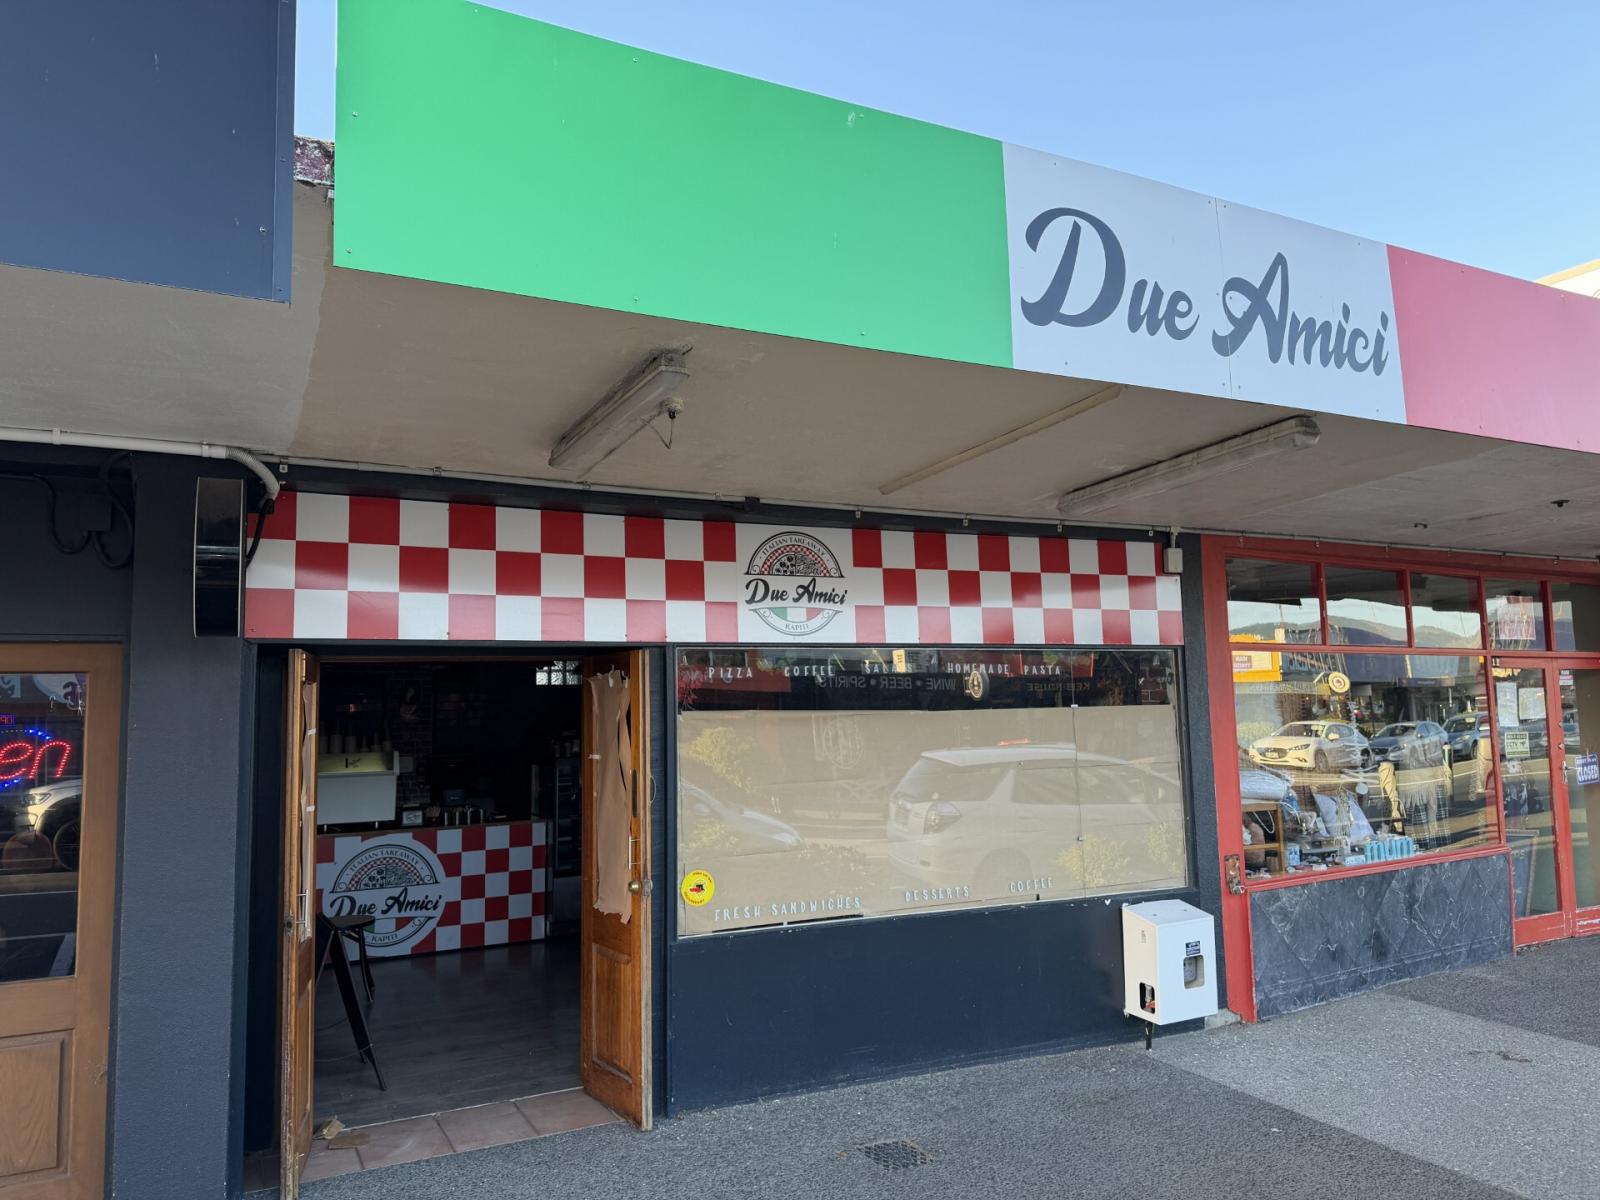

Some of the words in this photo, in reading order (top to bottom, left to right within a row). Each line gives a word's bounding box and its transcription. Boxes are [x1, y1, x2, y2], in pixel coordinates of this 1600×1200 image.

[1020, 207, 1199, 340] Due
[1211, 251, 1389, 376] Amici
[762, 537, 788, 556] ITALIAN
[789, 536, 826, 557] TAKEAWAY
[745, 578, 789, 605] Due
[792, 577, 848, 605] Amici
[708, 666, 753, 679] PIZZA
[784, 665, 835, 677] COFFEE
[947, 662, 1009, 674] HOMEMADE
[1024, 665, 1060, 675] PASTA
[350, 852, 379, 872] ITALIAN
[380, 849, 419, 865] TAKEAWAY
[330, 895, 377, 916] Due
[381, 887, 442, 915] Amici
[905, 886, 969, 902] DESSERTS
[714, 906, 761, 921] FRESH
[771, 897, 862, 916] SANDWICHES
